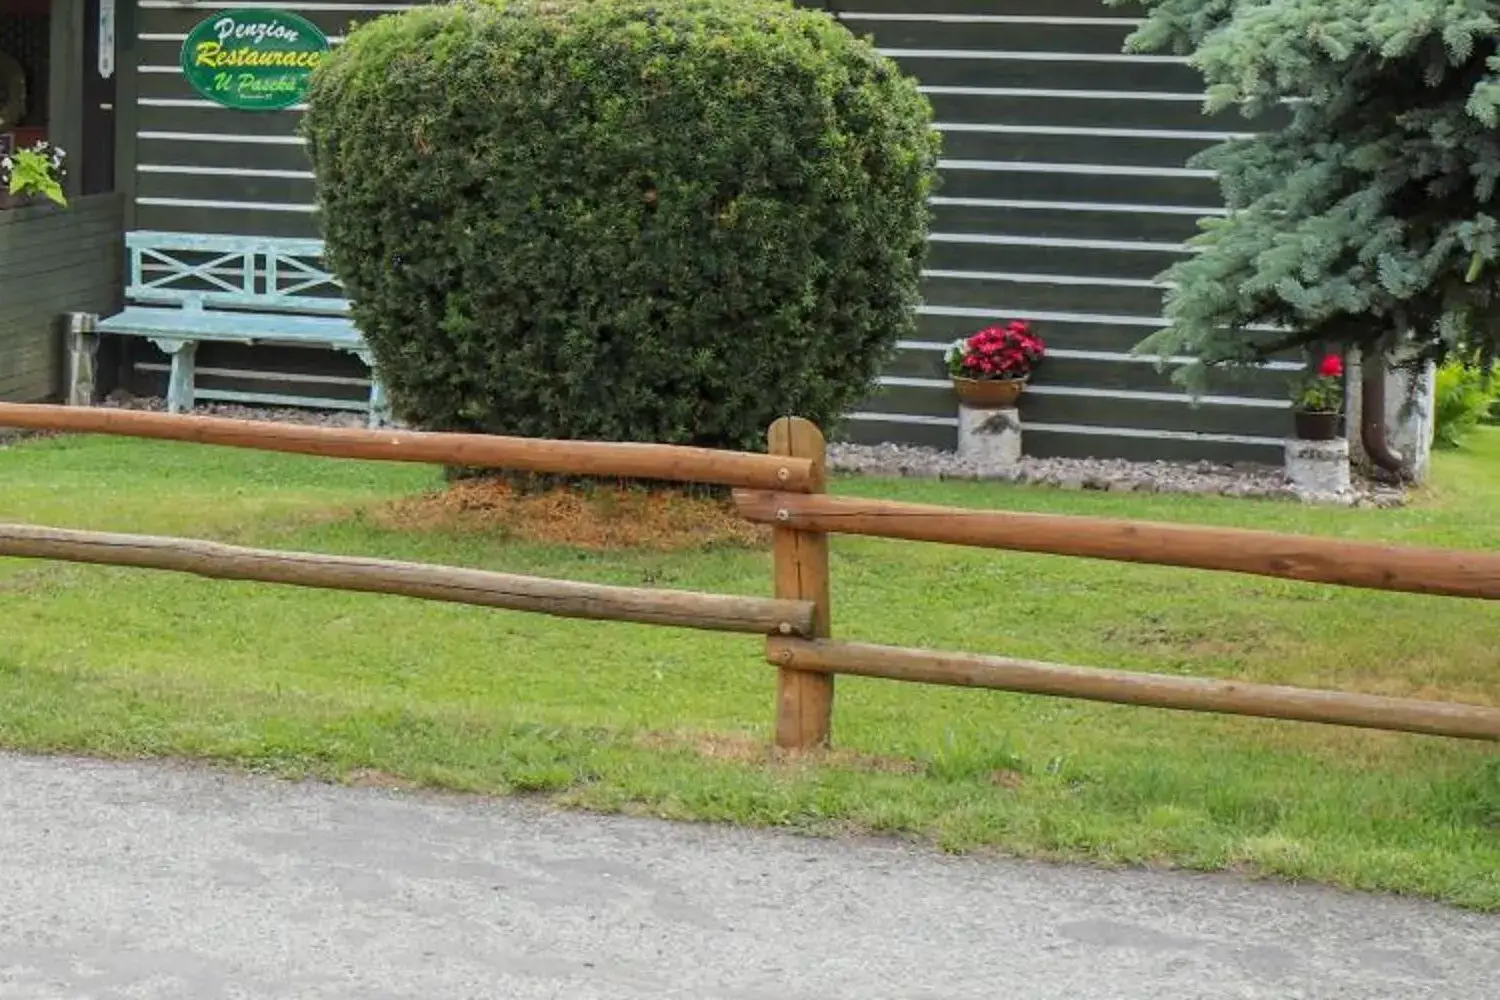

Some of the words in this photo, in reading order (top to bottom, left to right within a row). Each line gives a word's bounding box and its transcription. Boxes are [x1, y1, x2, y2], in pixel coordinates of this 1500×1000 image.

[213, 17, 299, 46] Penzion
[195, 41, 321, 68] Restaurace
[214, 72, 233, 91] U
